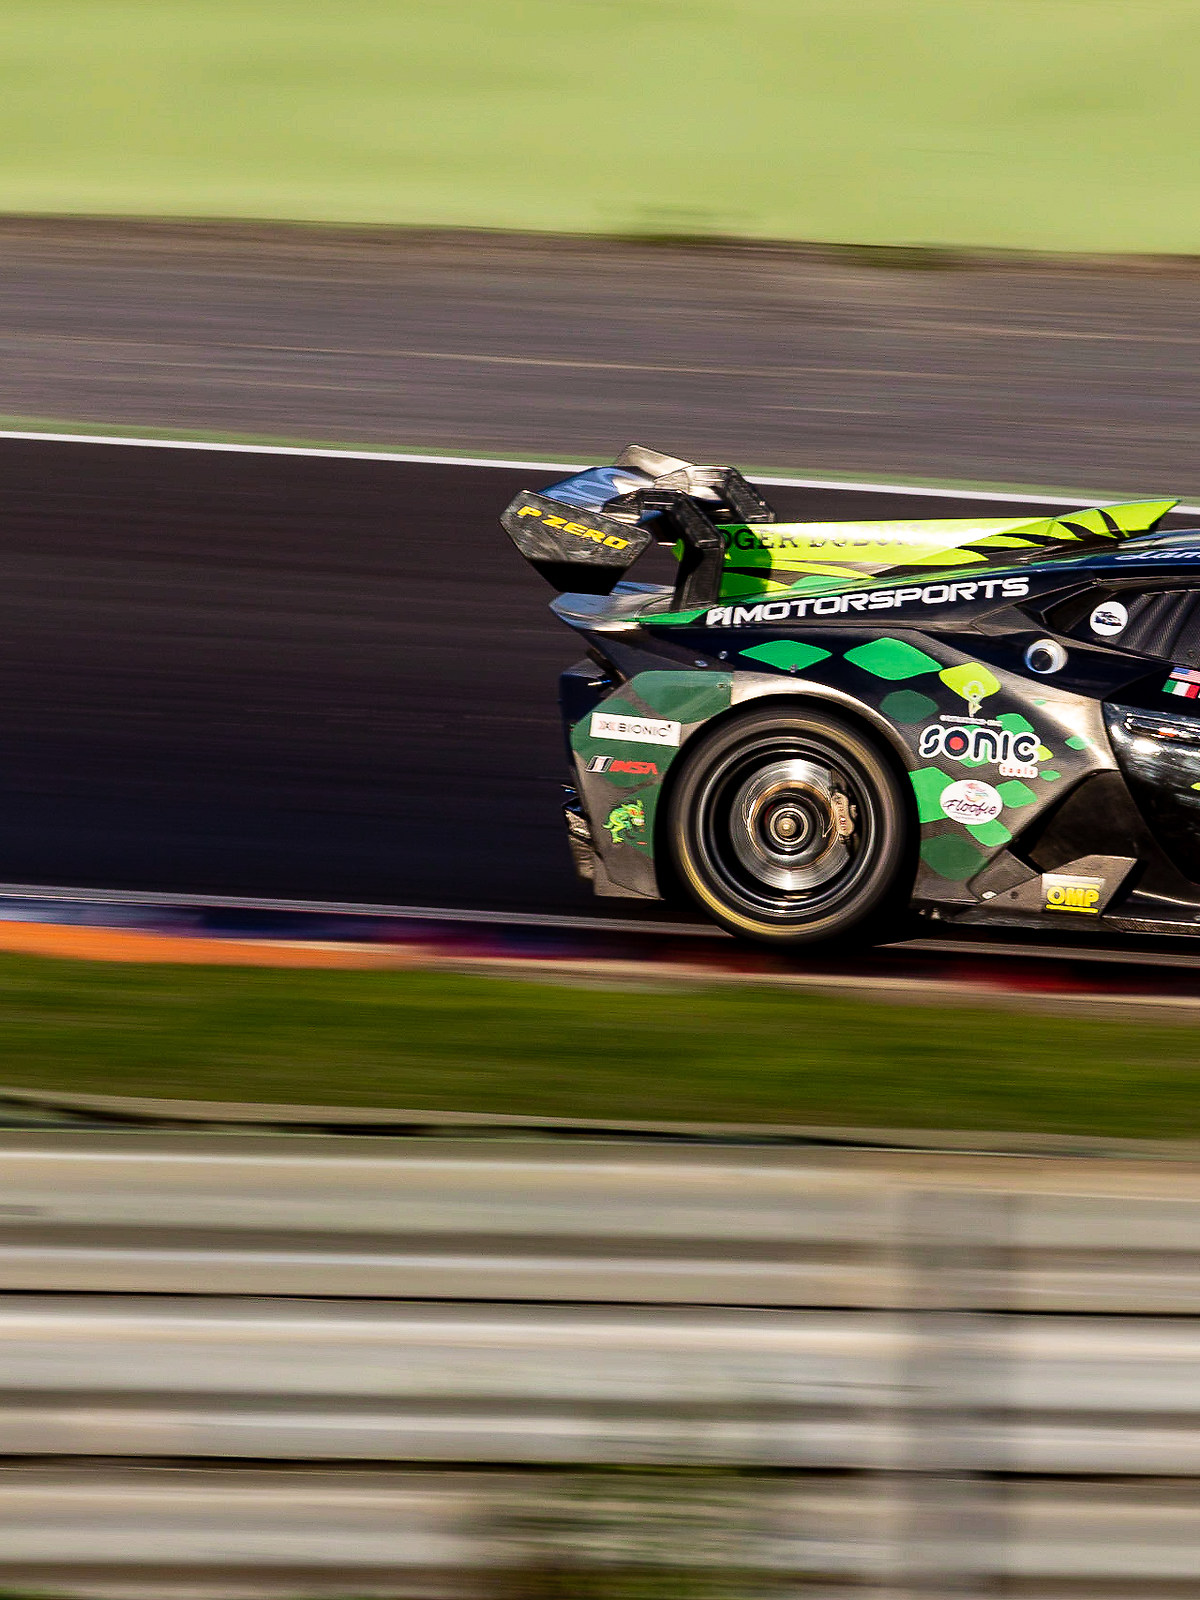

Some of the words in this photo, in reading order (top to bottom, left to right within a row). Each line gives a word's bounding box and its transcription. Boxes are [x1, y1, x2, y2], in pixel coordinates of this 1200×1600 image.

[517, 505, 542, 517] P
[542, 514, 632, 550] ZERO
[732, 577, 1030, 625] MOTORSPORTS
[1046, 886, 1099, 907] OMP
